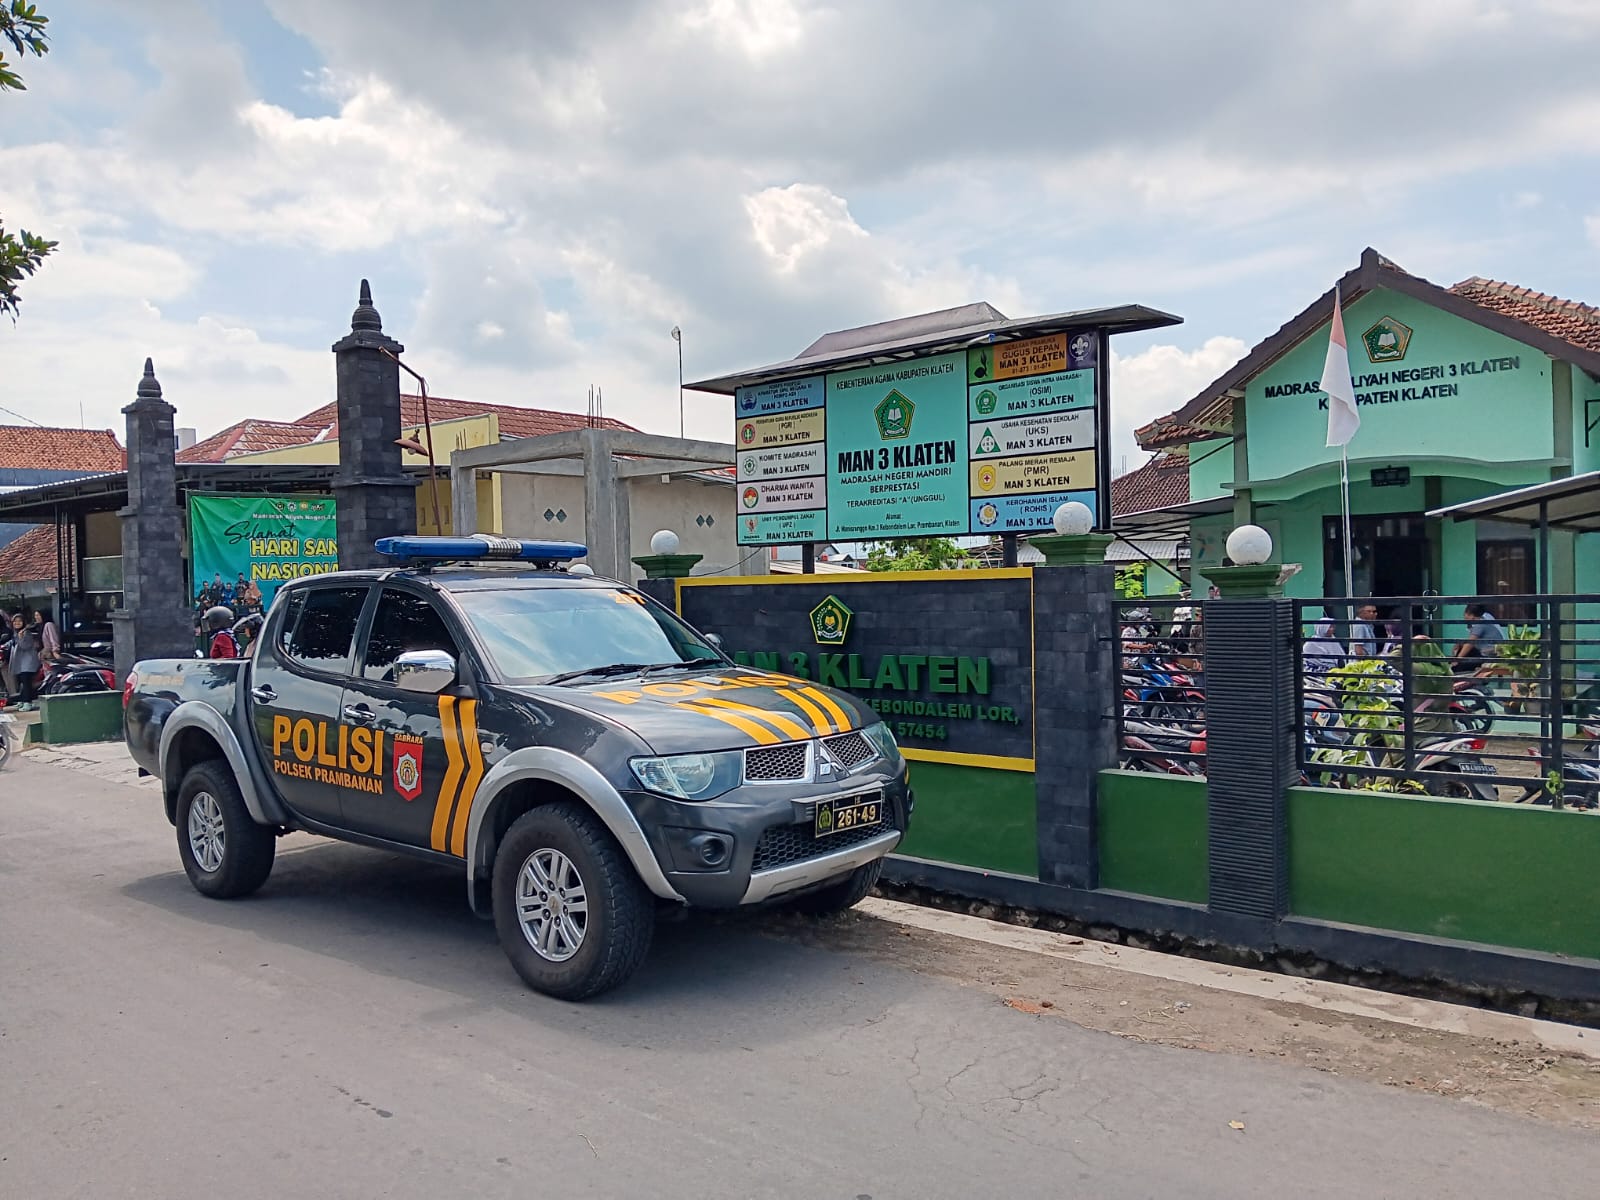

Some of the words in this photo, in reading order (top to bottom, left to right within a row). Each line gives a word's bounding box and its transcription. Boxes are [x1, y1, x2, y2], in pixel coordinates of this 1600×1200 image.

[1002, 347, 1030, 359] GUGUS
[1033, 344, 1060, 354] DEPAN
[1000, 359, 1018, 369] MAN
[1022, 357, 1026, 365] 3
[1030, 351, 1065, 364] KLATEN
[837, 378, 874, 390] KEMENTERIAN
[875, 374, 895, 384] AGAMA
[896, 367, 929, 381] KABUPATEN
[930, 363, 954, 375] KLATEN
[1265, 381, 1321, 398] MADRAS
[1351, 372, 1389, 389] LIYAH
[1392, 365, 1444, 383] NEGERI
[1449, 365, 1457, 377] 3
[1460, 356, 1520, 376] KLATEN
[1029, 385, 1052, 397] (OSIM)
[1319, 390, 1399, 410] KPATEN
[1402, 383, 1458, 401] KLATEN
[783, 398, 808, 408] KLATEN
[1008, 401, 1027, 411] MAN
[1030, 400, 1036, 408] 3
[1038, 394, 1074, 407] KLATEN
[1020, 417, 1053, 427] KESEHATAN
[1053, 415, 1079, 423] SEKOLAH
[785, 432, 810, 441] KLATEN
[1025, 426, 1049, 437] (UKS)
[1006, 440, 1026, 450] MAN
[1028, 439, 1034, 448] 3
[1037, 435, 1072, 446] KLATEN
[783, 450, 816, 459] MADRASAH
[838, 449, 874, 474] MAN
[878, 448, 889, 470] 3
[893, 440, 956, 468] KLATEN
[999, 459, 1024, 467] PALANG
[1025, 457, 1048, 465] MERAH
[785, 464, 810, 473] KLATEN
[841, 474, 882, 485] MADRASAH
[885, 471, 914, 481] NEGERI
[916, 467, 951, 478] MANDIRI
[1023, 466, 1049, 477] (PMR)
[761, 485, 789, 493] DHARMA
[790, 482, 814, 491] WANITA
[870, 482, 920, 494] BERPRESTASI
[1004, 480, 1024, 489] MAN
[1026, 479, 1031, 488] 3
[1034, 476, 1070, 487] KLATEN
[787, 493, 813, 501] KLATEN
[847, 498, 897, 508] TERAKREDITASI
[1006, 498, 1047, 506] KEROHANIAN
[1048, 495, 1069, 503] ISLAM
[1006, 518, 1026, 527] MAN
[1028, 518, 1034, 526] 3
[1036, 517, 1054, 526] KLA
[224, 521, 295, 544] Selamat
[787, 530, 813, 539] KLATEN
[250, 539, 299, 556] HARI
[304, 539, 337, 556] SAN
[251, 563, 338, 580] NASION
[788, 651, 810, 678] 3
[818, 653, 992, 695] KLATEN
[592, 673, 809, 704] POLISI
[977, 705, 1019, 725] LOR,
[898, 721, 946, 740] 57454
[273, 714, 385, 776] POLISI
[274, 759, 313, 780] POLSEK
[314, 767, 383, 795] PRAMBANAN
